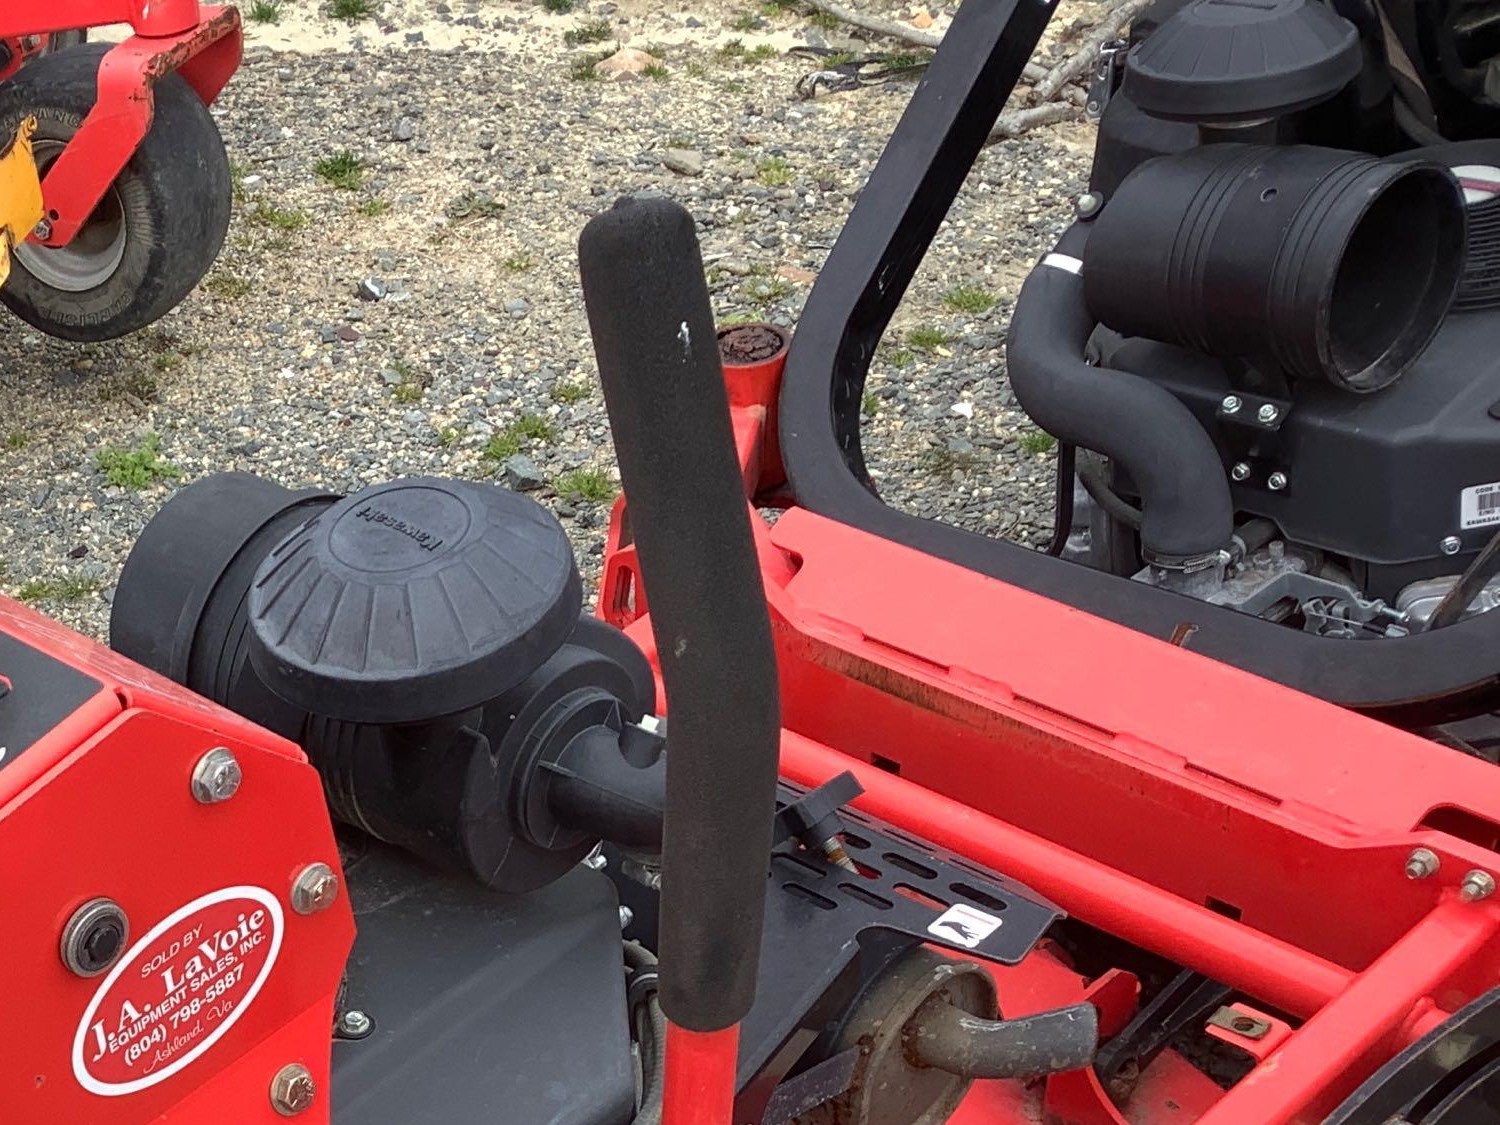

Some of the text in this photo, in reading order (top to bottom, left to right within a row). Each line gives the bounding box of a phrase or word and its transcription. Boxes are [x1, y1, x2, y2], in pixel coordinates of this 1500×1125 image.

[356, 507, 443, 551] Kawasaki
[108, 930, 266, 1054] EQUIPMENT SALES, INC.
[141, 923, 203, 978] SOLD BY
[160, 908, 266, 996] LaVoie
[124, 963, 245, 1067] (804) 798-5887
